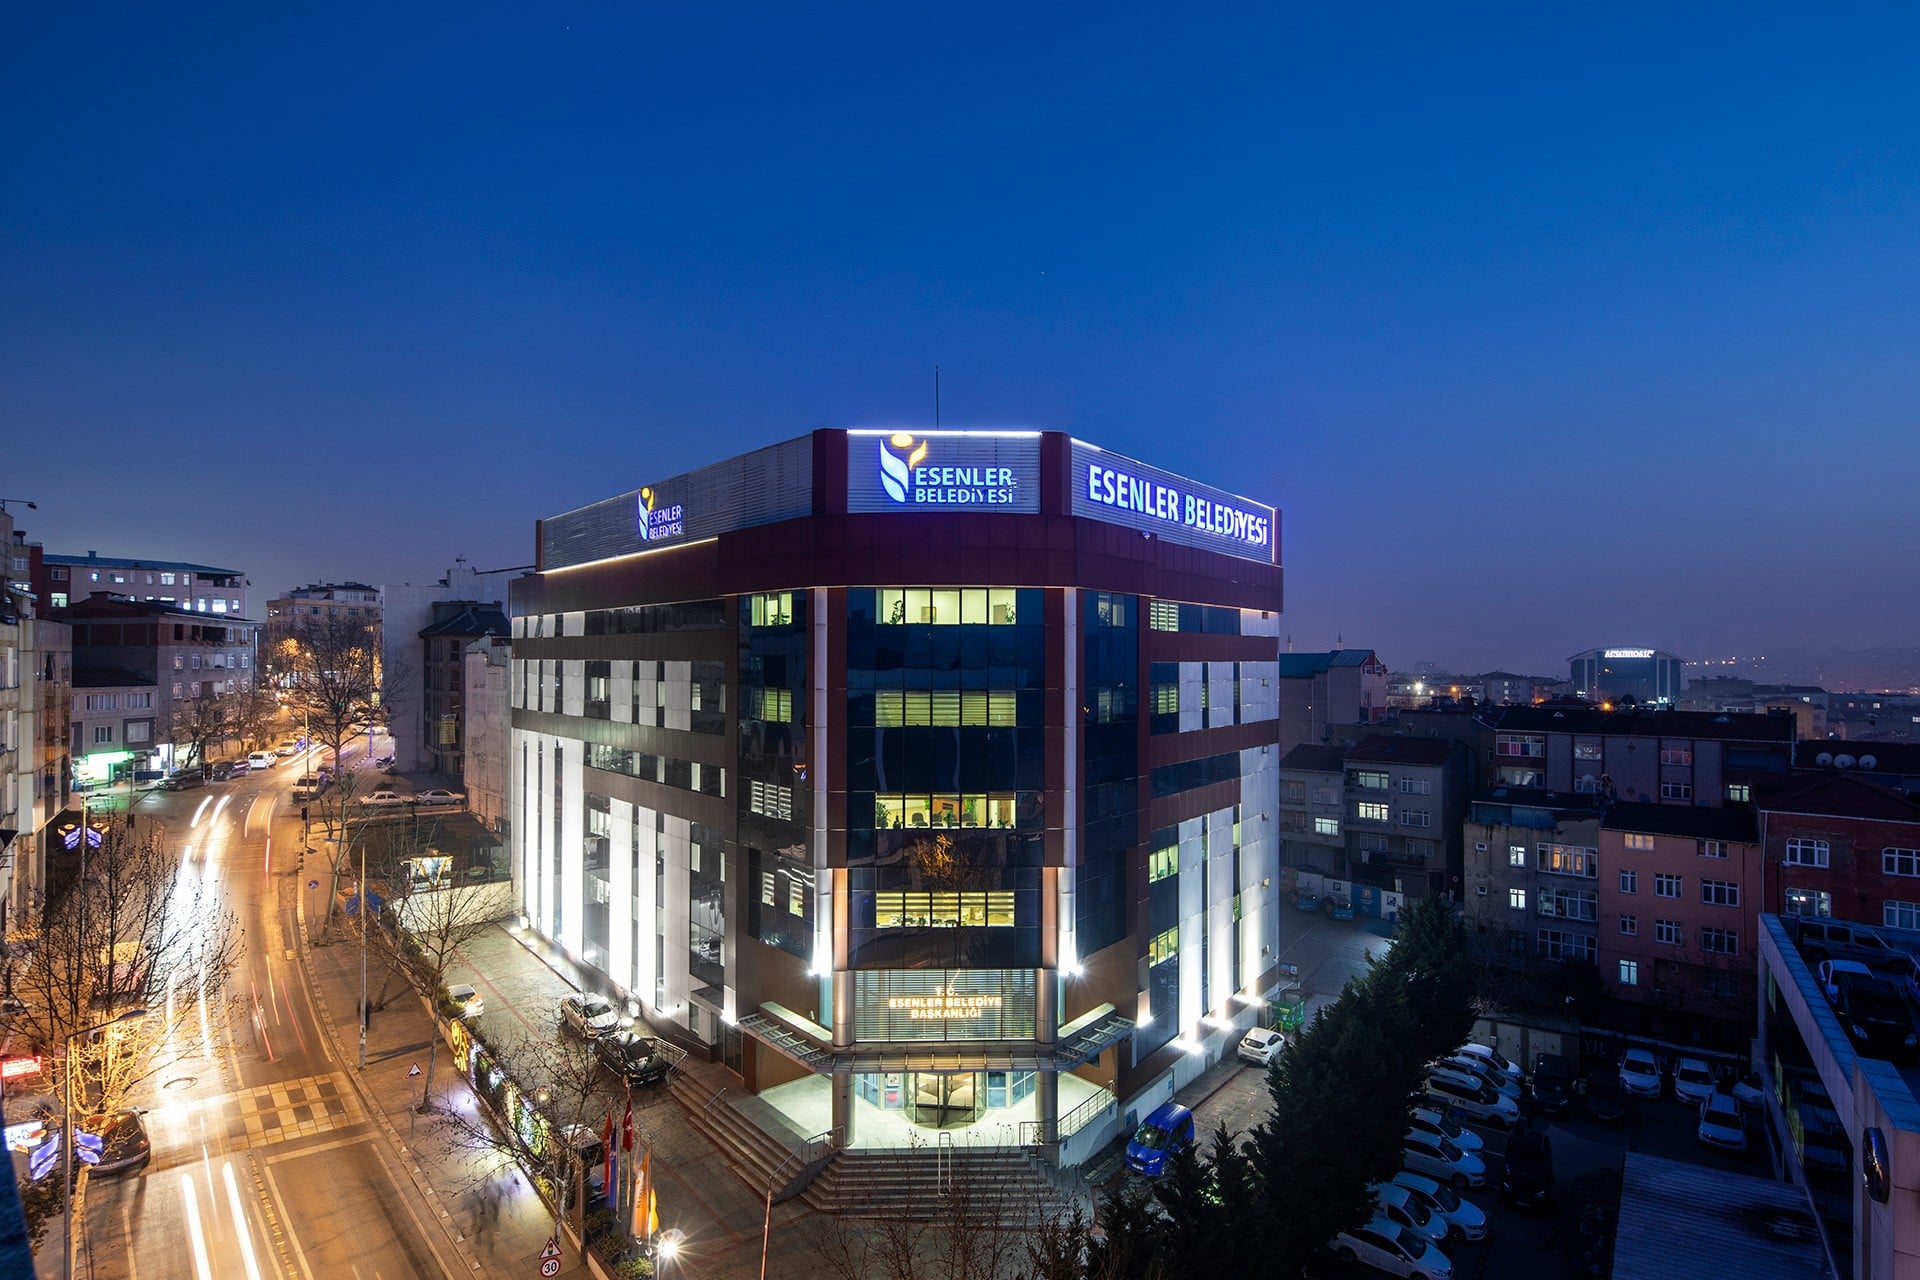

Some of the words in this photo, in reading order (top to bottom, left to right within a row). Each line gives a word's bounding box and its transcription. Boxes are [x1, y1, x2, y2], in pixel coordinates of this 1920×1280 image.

[916, 467, 1013, 486] ESENLER
[1089, 464, 1179, 522] ESENLER
[649, 505, 682, 526] ESENLER
[888, 998, 943, 1008] ESENLER
[544, 1261, 557, 1273] 30
